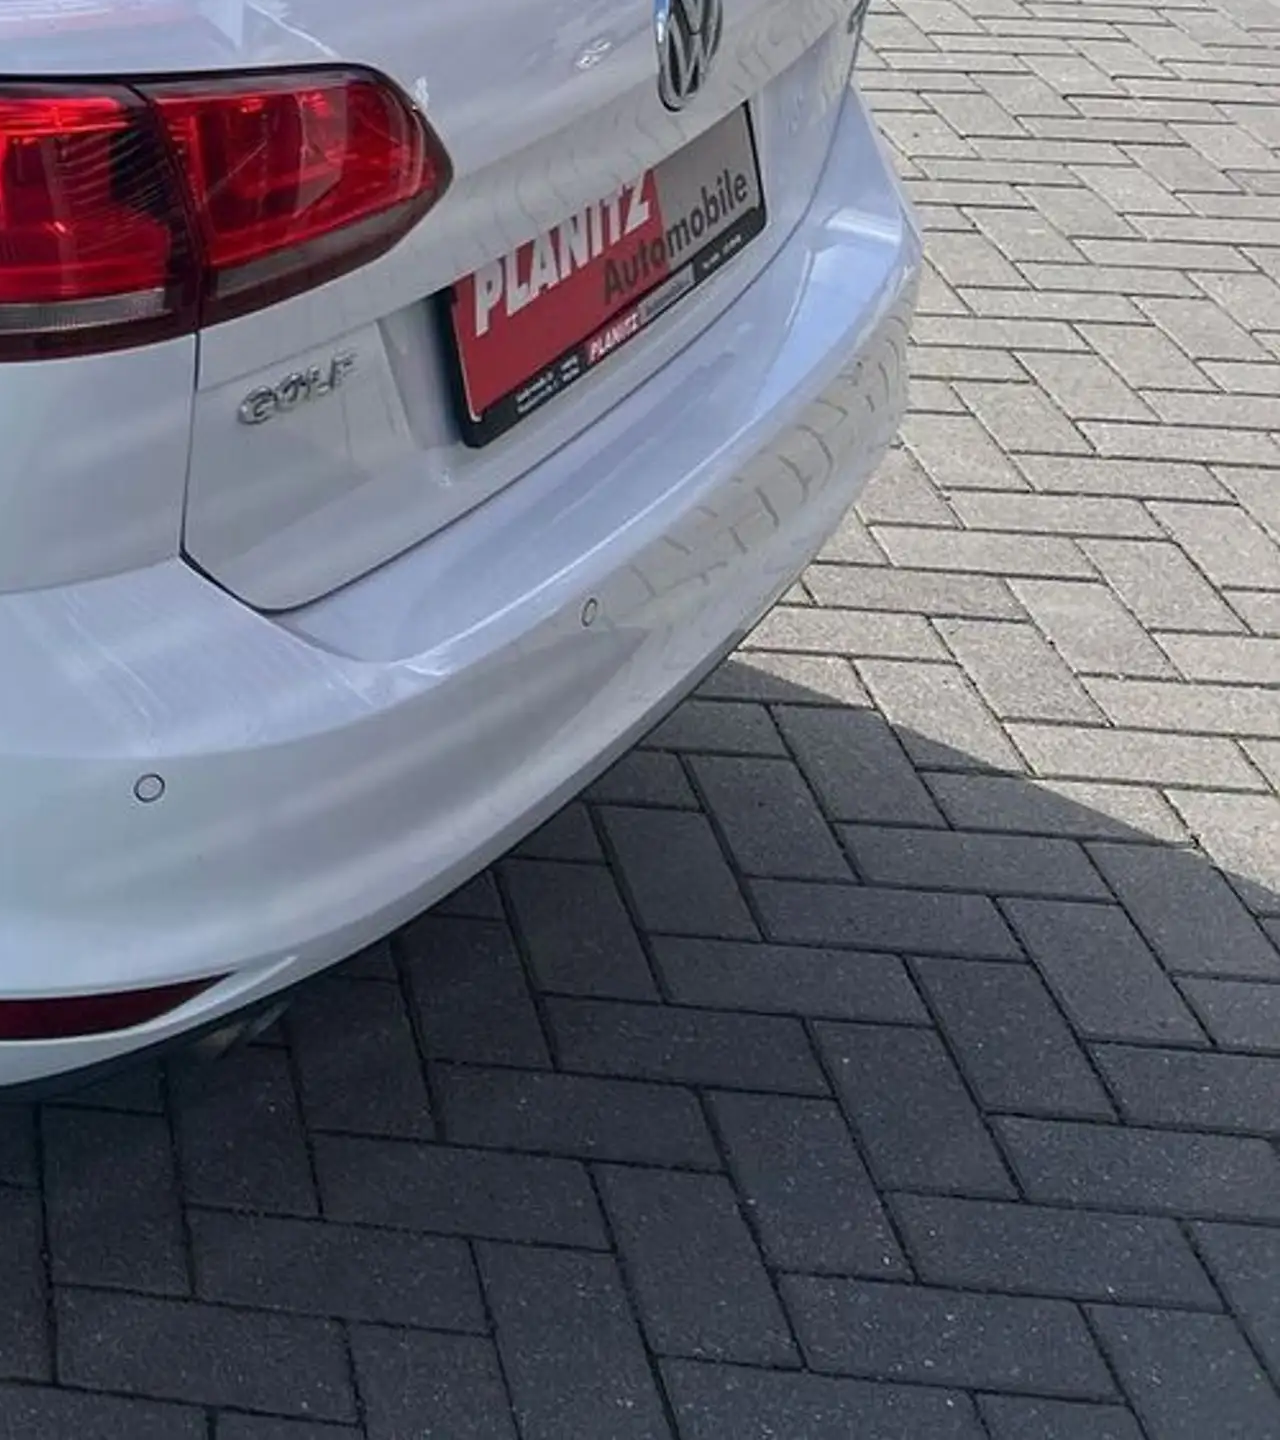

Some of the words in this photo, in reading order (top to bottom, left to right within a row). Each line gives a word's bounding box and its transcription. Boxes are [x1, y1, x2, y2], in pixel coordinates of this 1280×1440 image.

[472, 169, 651, 338] PLANITZ
[601, 168, 749, 305] Automobile
[237, 353, 358, 426] GOLF
